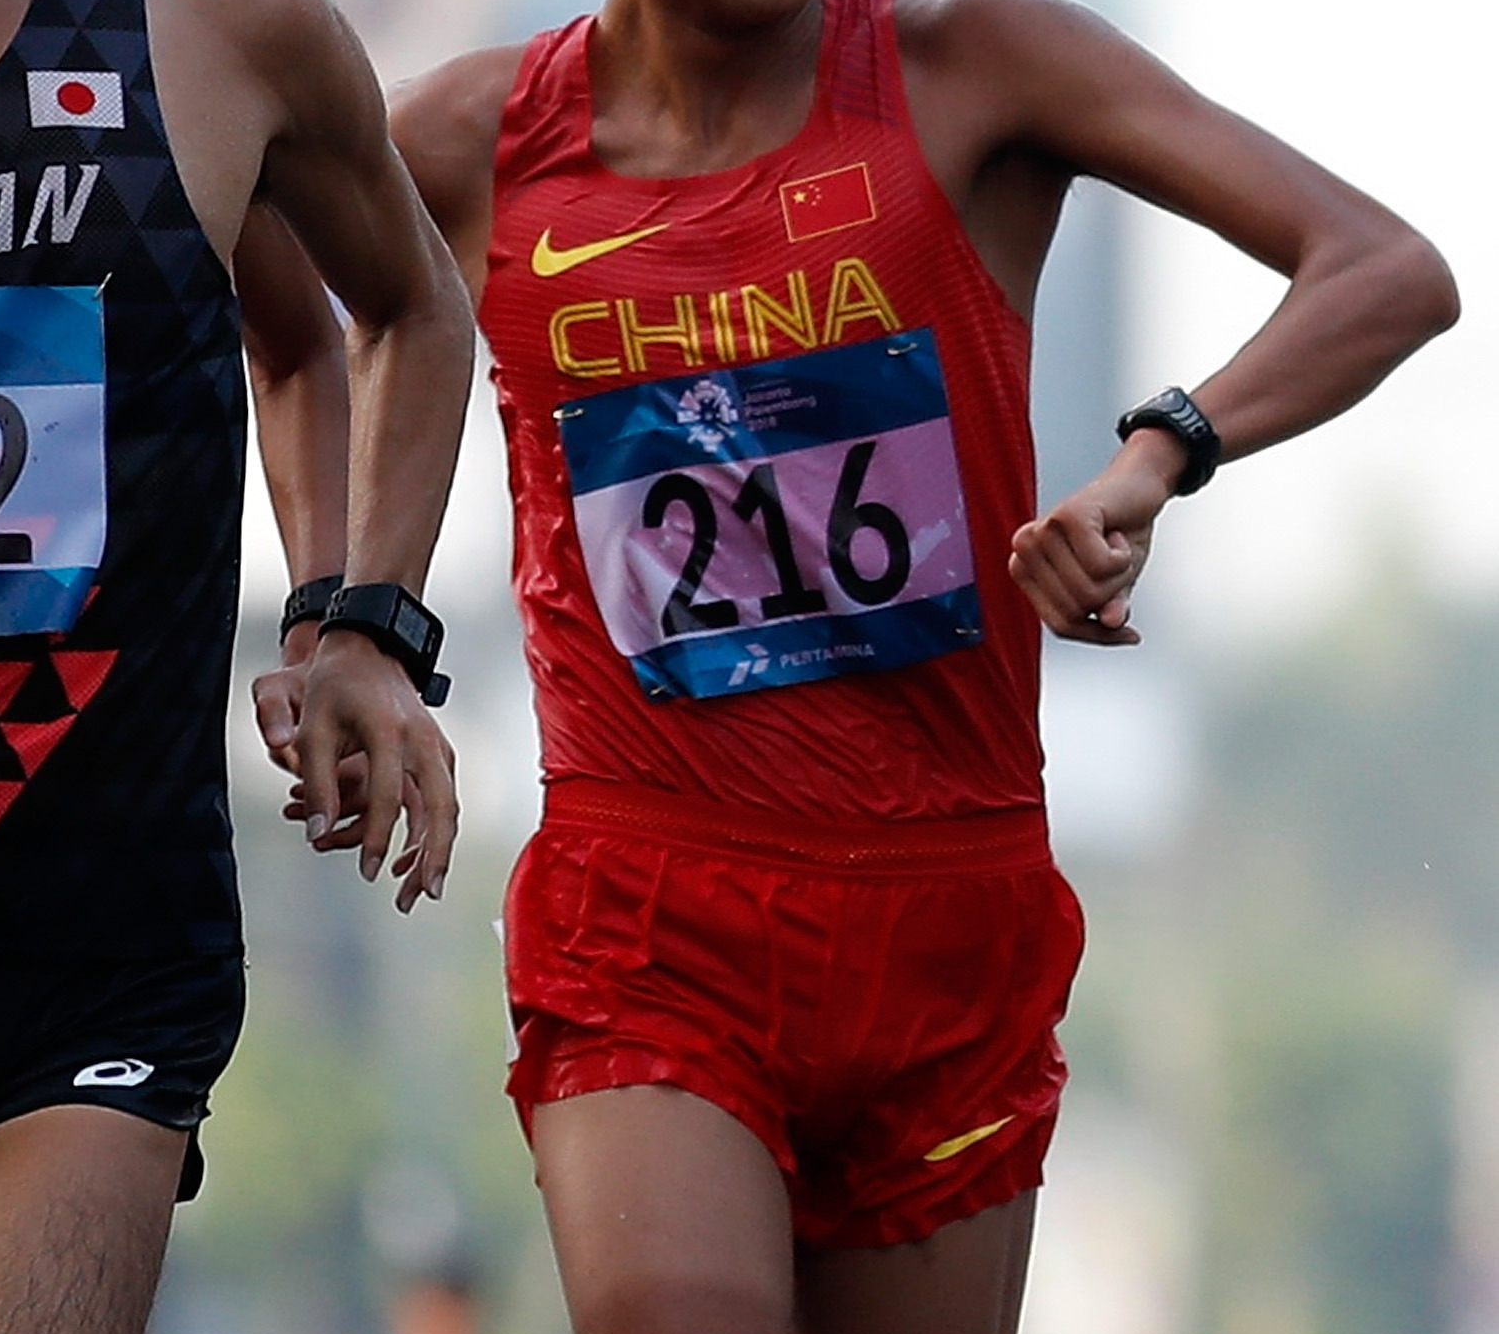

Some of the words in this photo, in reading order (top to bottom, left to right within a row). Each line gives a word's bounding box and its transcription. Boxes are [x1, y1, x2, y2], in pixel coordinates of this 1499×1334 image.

[548, 257, 902, 378] CHINA
[642, 440, 912, 638] 216
[779, 643, 876, 669] PERTAMINA
